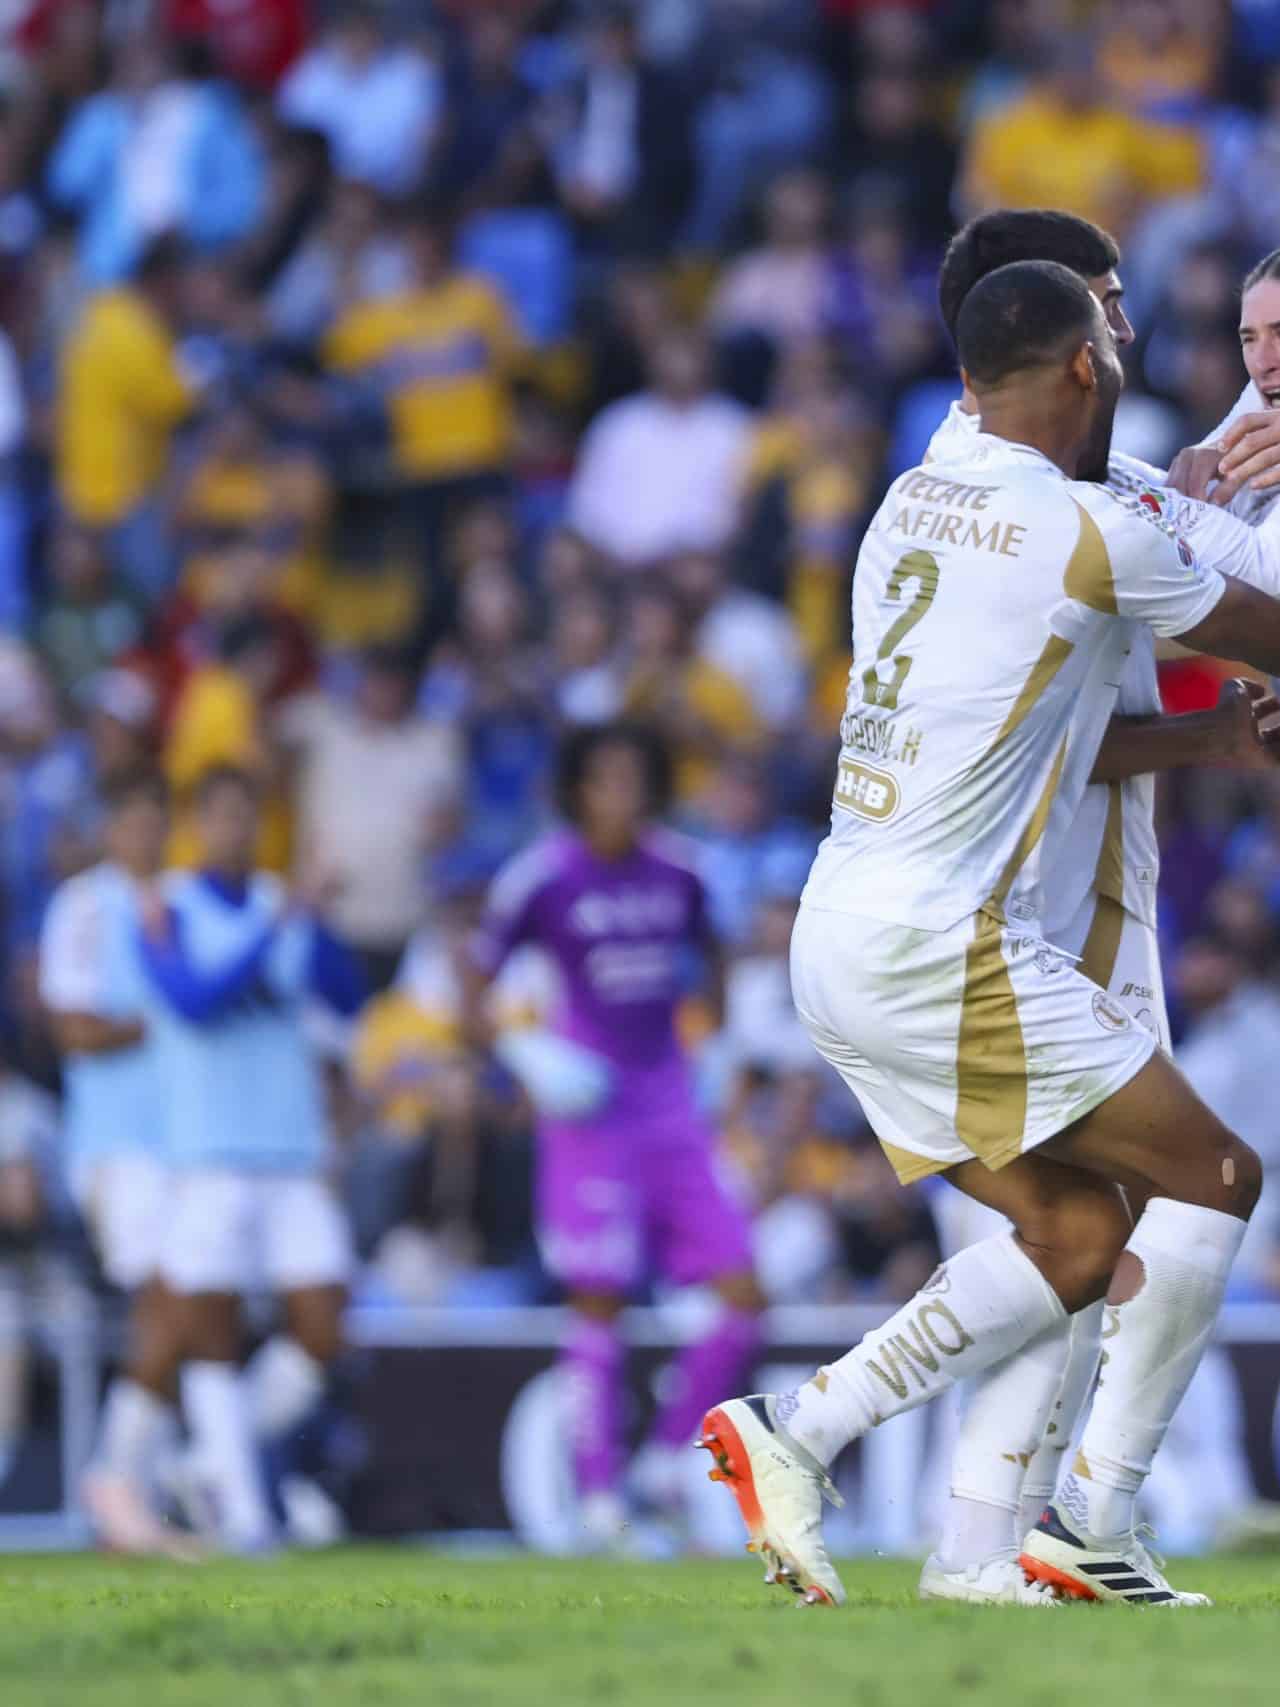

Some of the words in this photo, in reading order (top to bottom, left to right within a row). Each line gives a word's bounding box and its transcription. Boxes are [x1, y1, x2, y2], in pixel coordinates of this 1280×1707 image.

[897, 471, 1002, 511] TECATE
[890, 506, 1029, 559] AFIRME
[862, 550, 940, 710] 2
